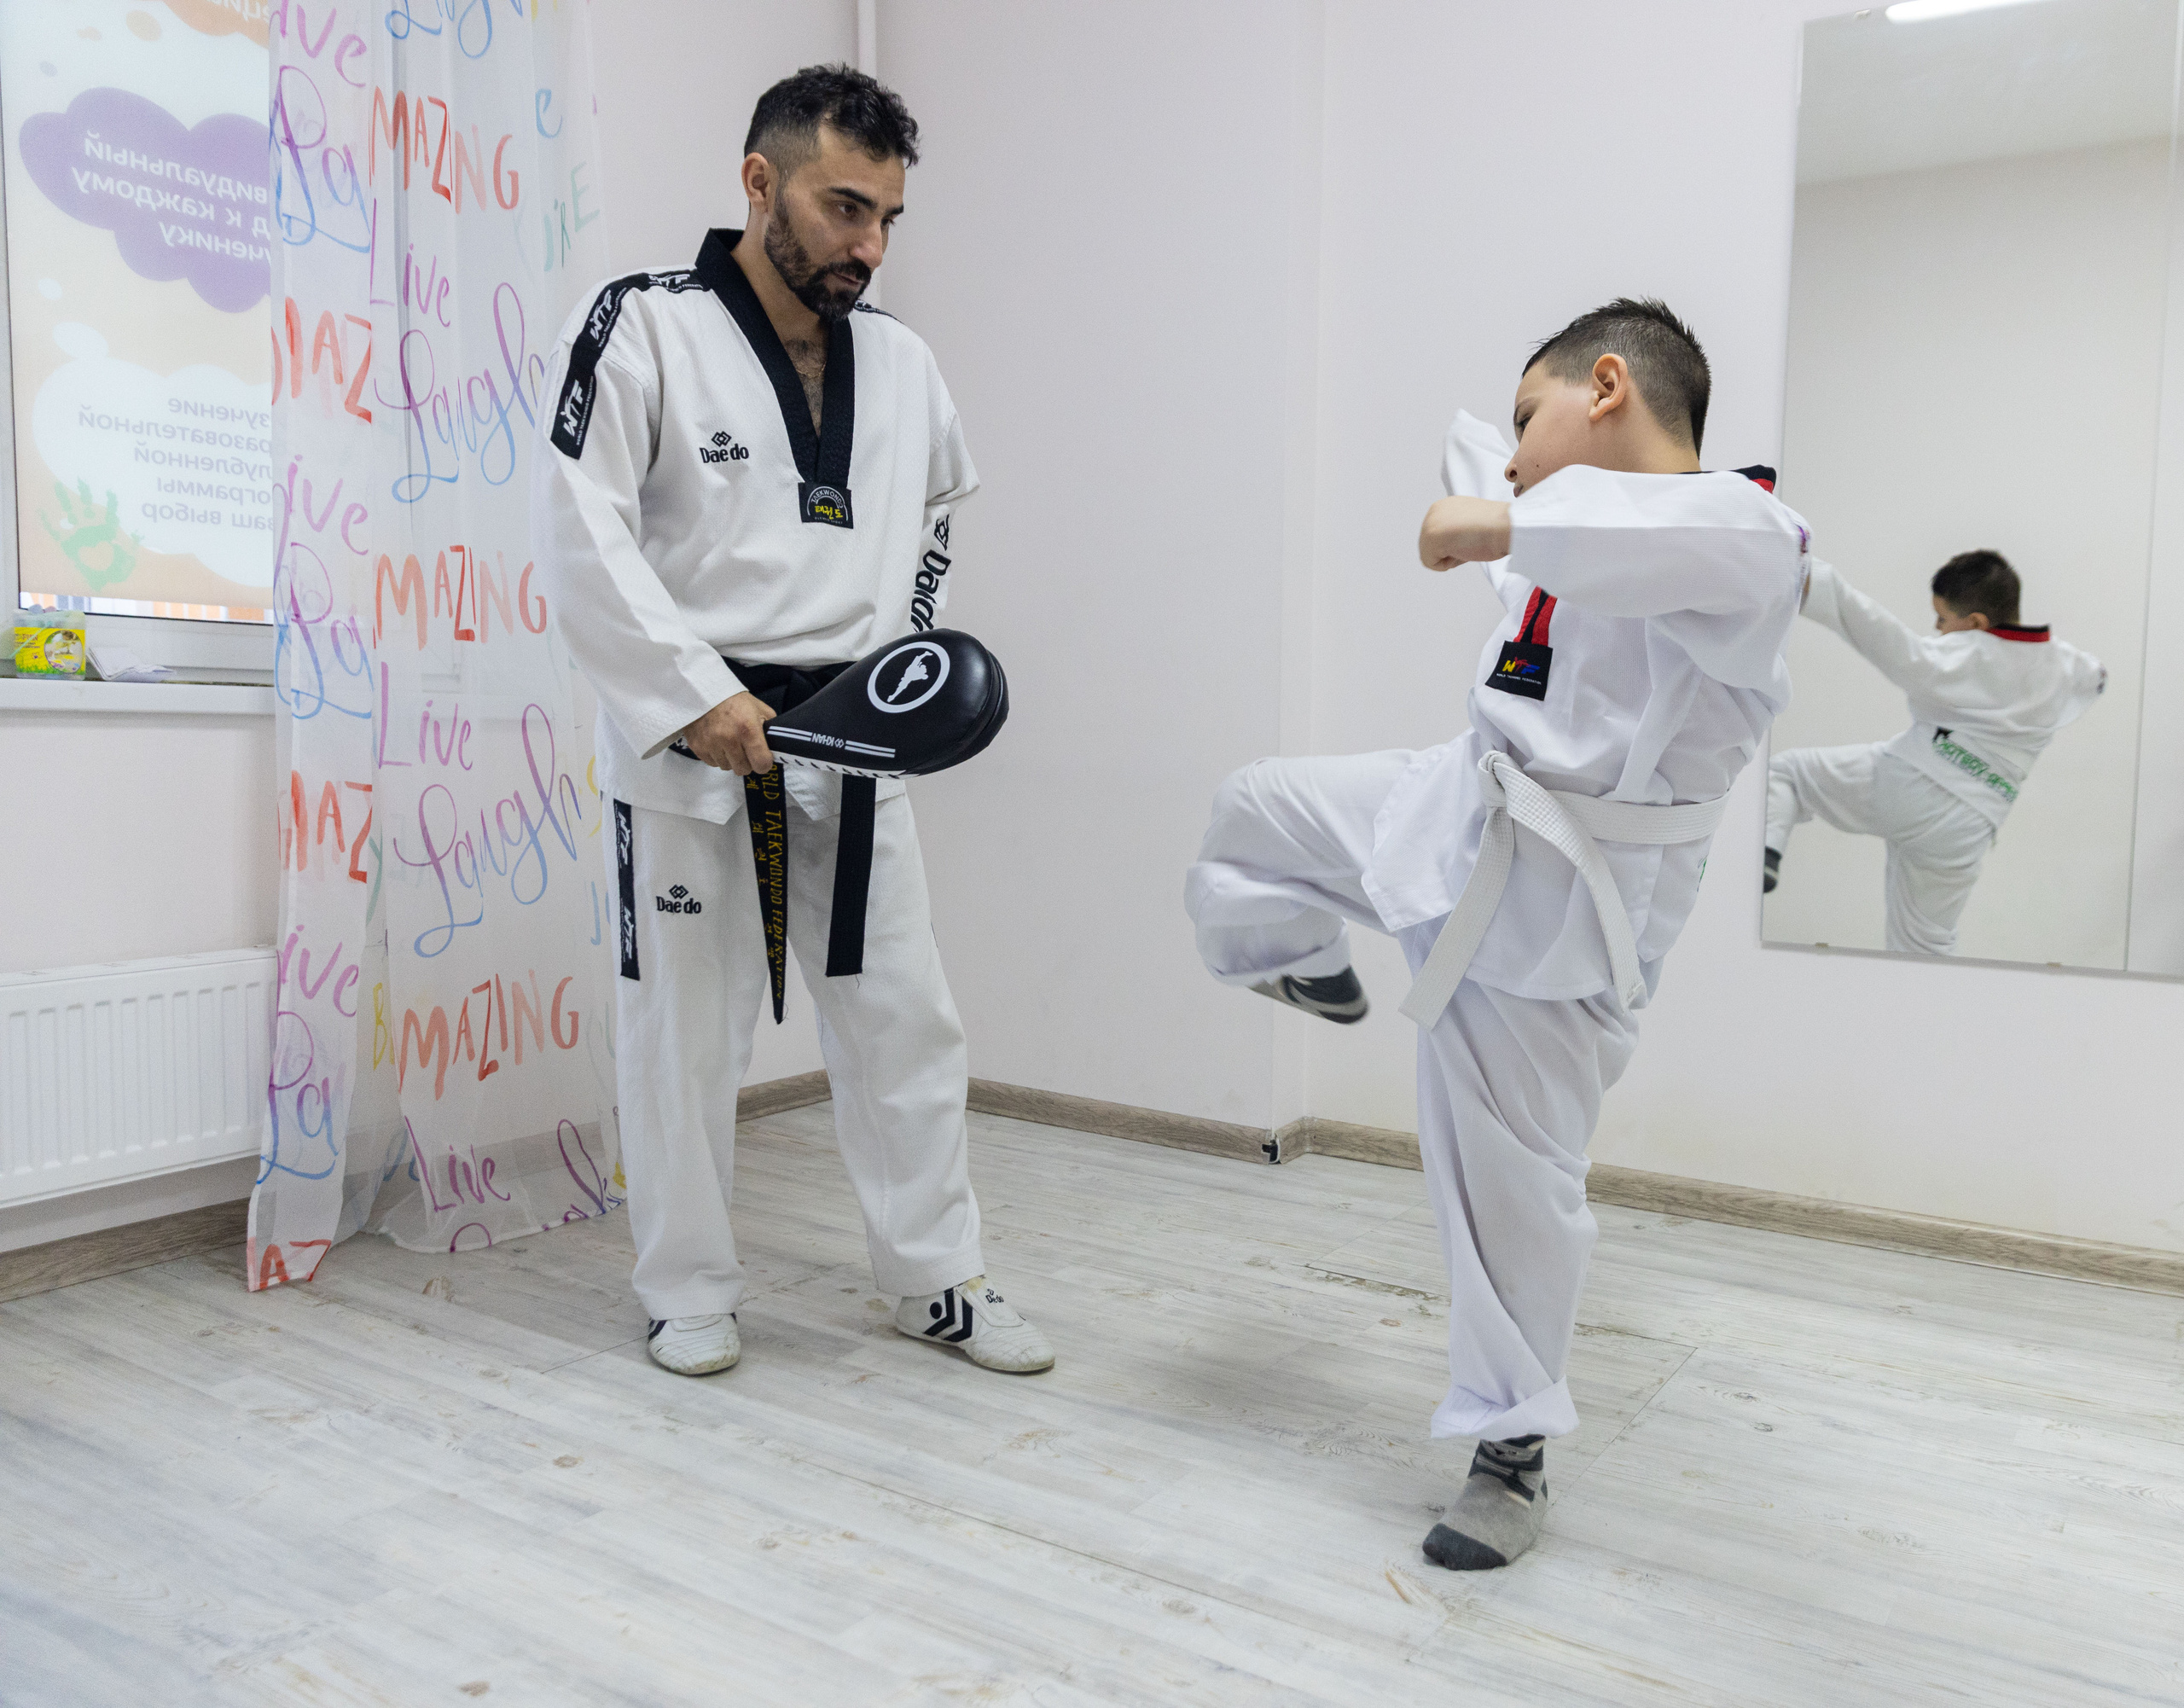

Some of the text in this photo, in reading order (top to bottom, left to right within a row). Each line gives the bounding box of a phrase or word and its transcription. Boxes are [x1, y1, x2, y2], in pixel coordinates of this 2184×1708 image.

[810, 490, 844, 508] TAEKWONDO
[378, 661, 473, 770] Live
[811, 733, 835, 747] KHAN
[765, 810, 783, 905] TAEKWONDO
[772, 909, 784, 999] FEDERATION
[404, 1115, 511, 1211] Live
